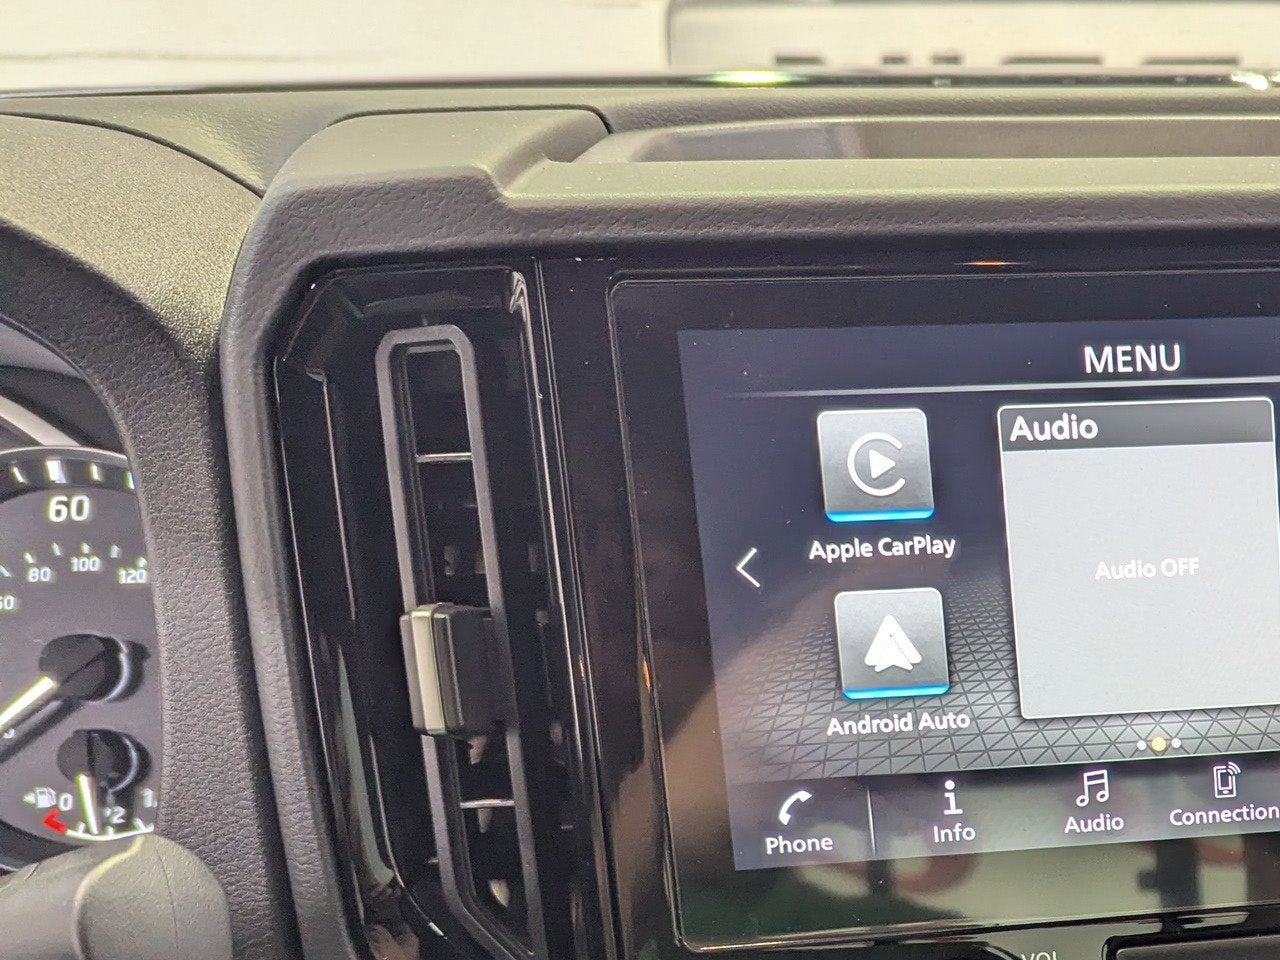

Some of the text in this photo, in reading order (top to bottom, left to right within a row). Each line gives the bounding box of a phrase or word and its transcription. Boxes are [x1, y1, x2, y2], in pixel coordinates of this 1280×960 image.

[1084, 343, 1181, 374] MENU
[1009, 414, 1099, 443] Audio
[49, 494, 90, 523] 60
[808, 535, 957, 563] Apple CarPlay
[28, 566, 52, 583] 80
[71, 555, 101, 573] 100
[118, 567, 149, 585] 120
[1094, 556, 1201, 581] Audio OFF
[826, 709, 971, 737] Android Auto
[58, 792, 73, 811] 0
[932, 822, 976, 844] Info
[1063, 812, 1125, 834] Audio
[765, 831, 833, 857] Phone
